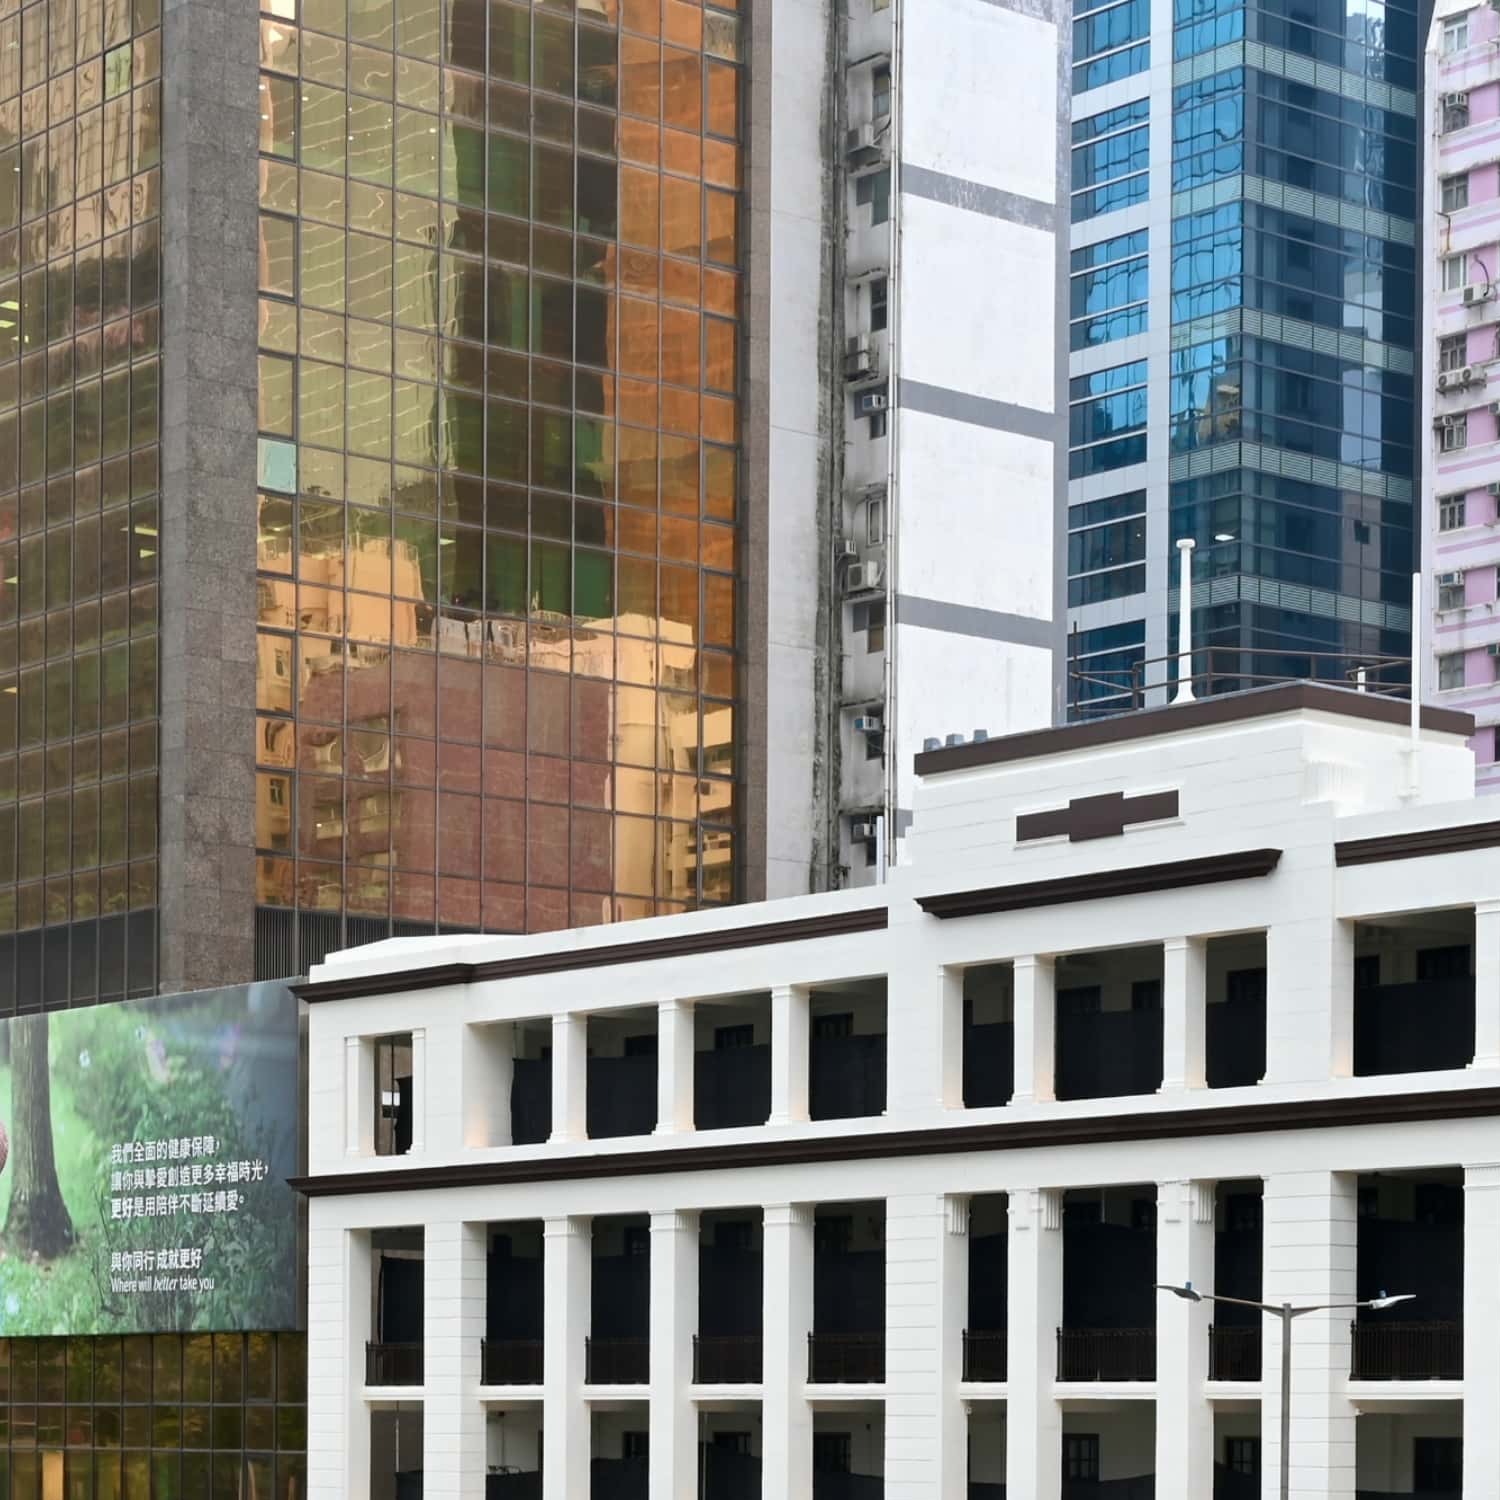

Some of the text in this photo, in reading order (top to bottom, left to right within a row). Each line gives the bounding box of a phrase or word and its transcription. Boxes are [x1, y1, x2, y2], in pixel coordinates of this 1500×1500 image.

[111, 1275, 215, 1294] Where will better take you
